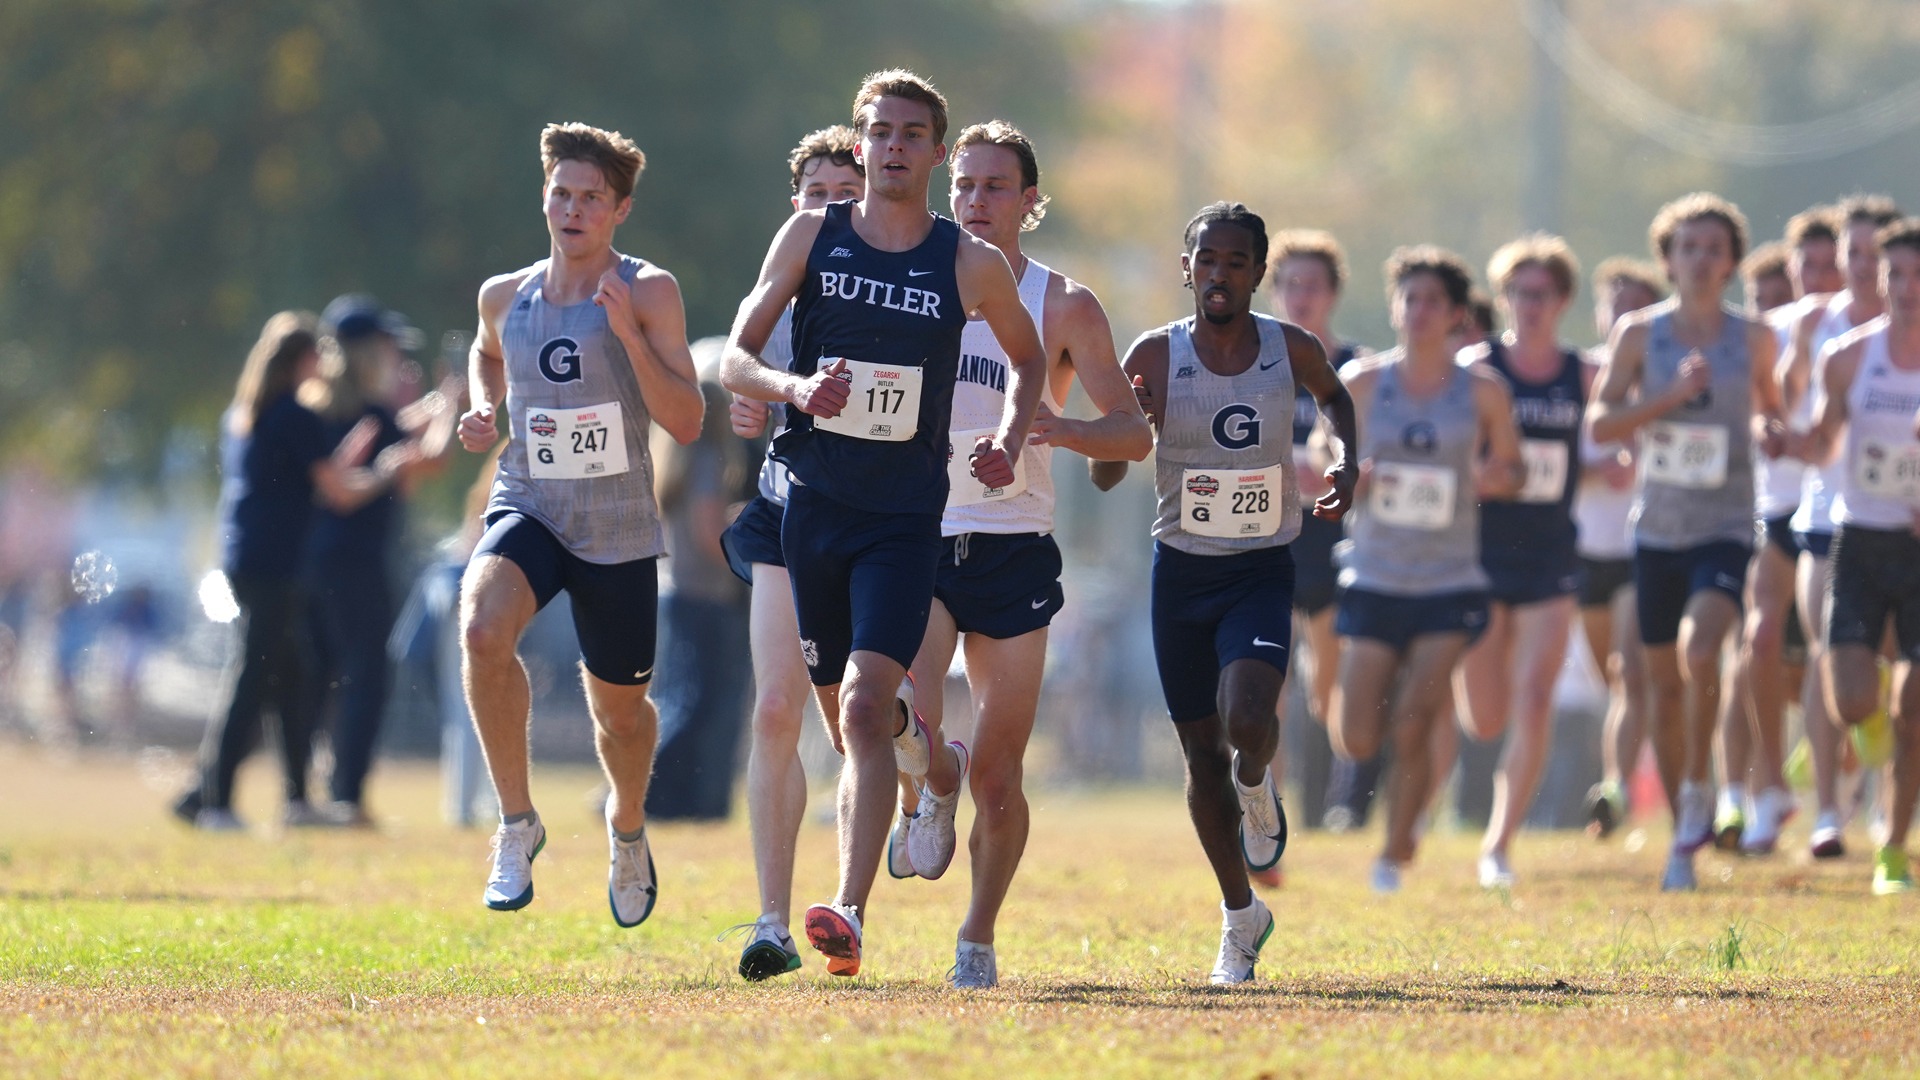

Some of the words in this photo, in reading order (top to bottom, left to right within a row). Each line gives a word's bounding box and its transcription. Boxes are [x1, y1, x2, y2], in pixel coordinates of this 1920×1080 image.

[820, 271, 941, 319] BUTLER
[537, 335, 583, 385] G
[873, 370, 901, 379] ZEGARSKI
[956, 354, 1006, 394] ANOVA
[866, 387, 905, 414] 117
[576, 412, 597, 421] WINTER
[1211, 402, 1264, 451] G
[571, 427, 608, 454] 247
[537, 447, 555, 464] G
[1192, 507, 1210, 522] G
[1232, 489, 1269, 514] 228
